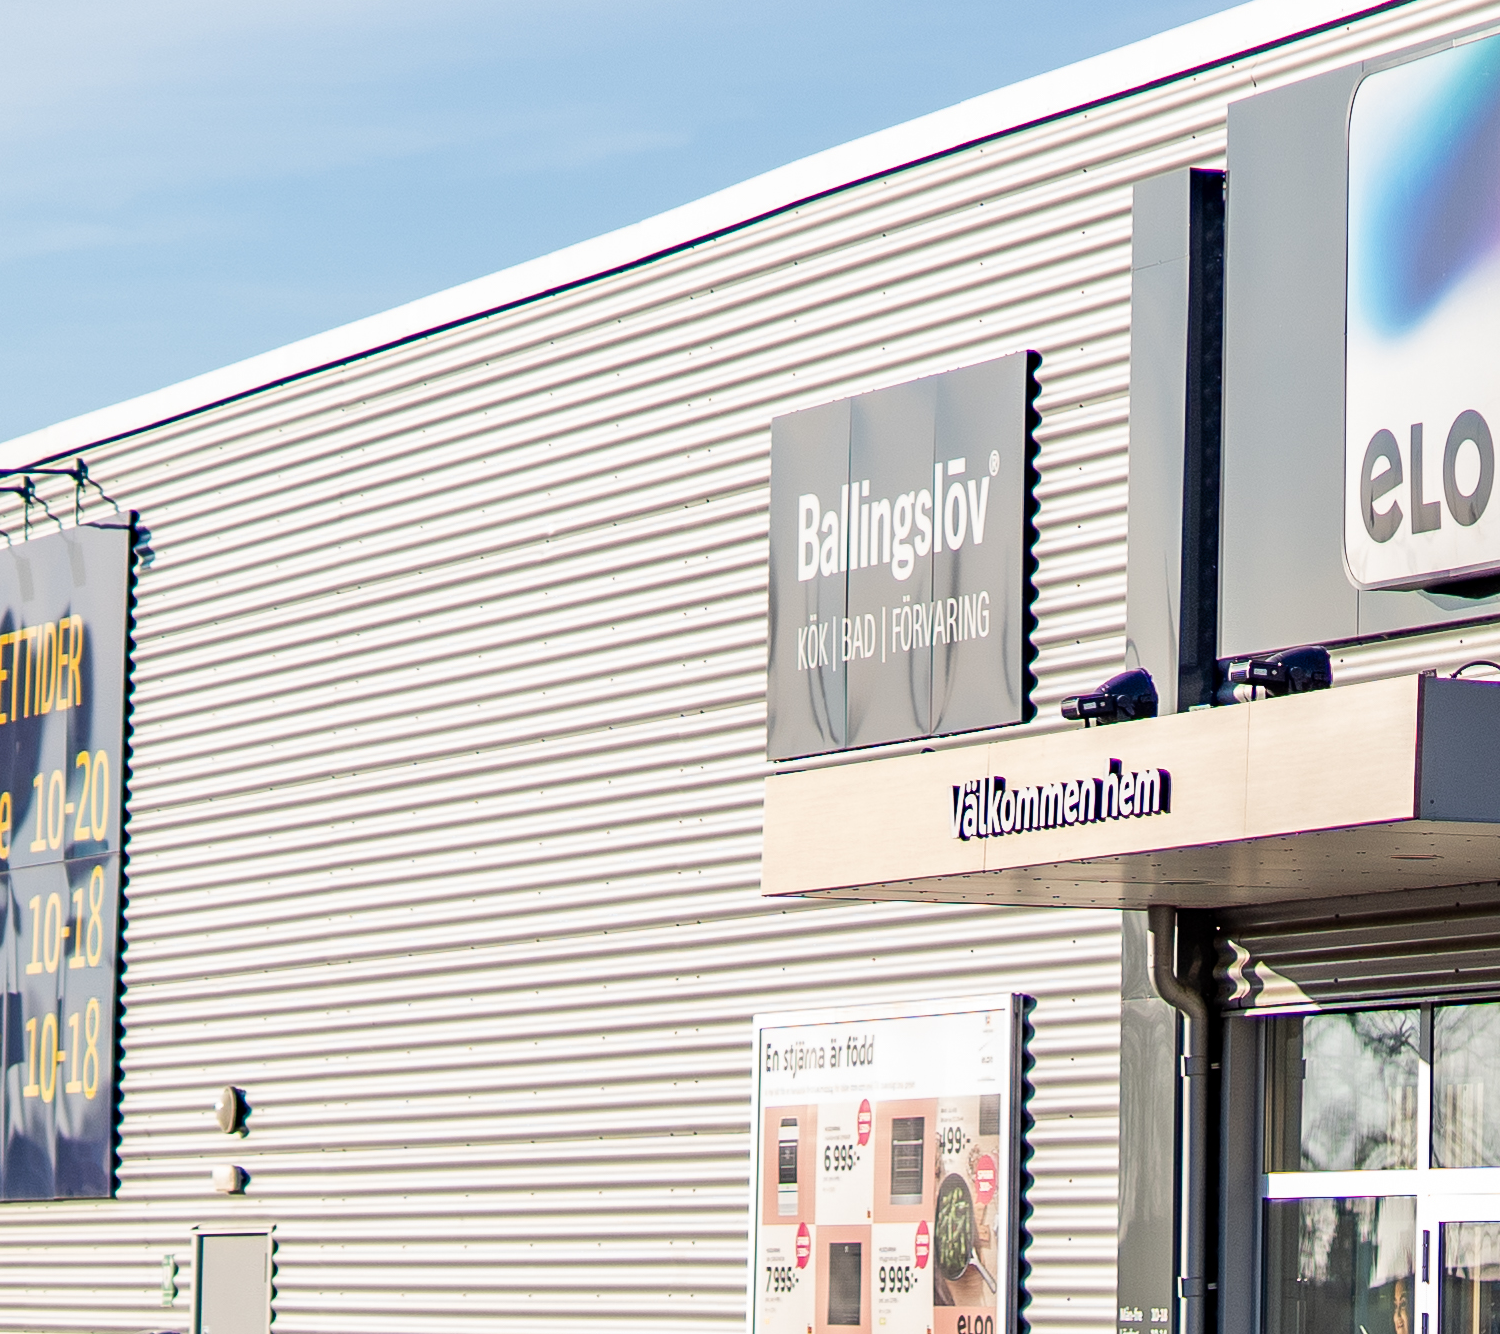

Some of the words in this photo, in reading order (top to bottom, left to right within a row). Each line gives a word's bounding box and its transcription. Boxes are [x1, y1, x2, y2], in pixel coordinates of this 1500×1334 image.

[797, 613, 828, 671] KÖK
[842, 613, 876, 662] BAD
[892, 590, 990, 653] FÖRVARING
[30, 749, 110, 853] 10-20
[949, 775, 1097, 840] Välkommen
[1101, 757, 1162, 819] hem
[25, 865, 104, 975] 10-18
[23, 997, 99, 1103] 10-18
[765, 1042, 780, 1072] En
[784, 1040, 825, 1079] stjärna
[830, 1038, 843, 1069] är
[847, 1034, 875, 1067] född
